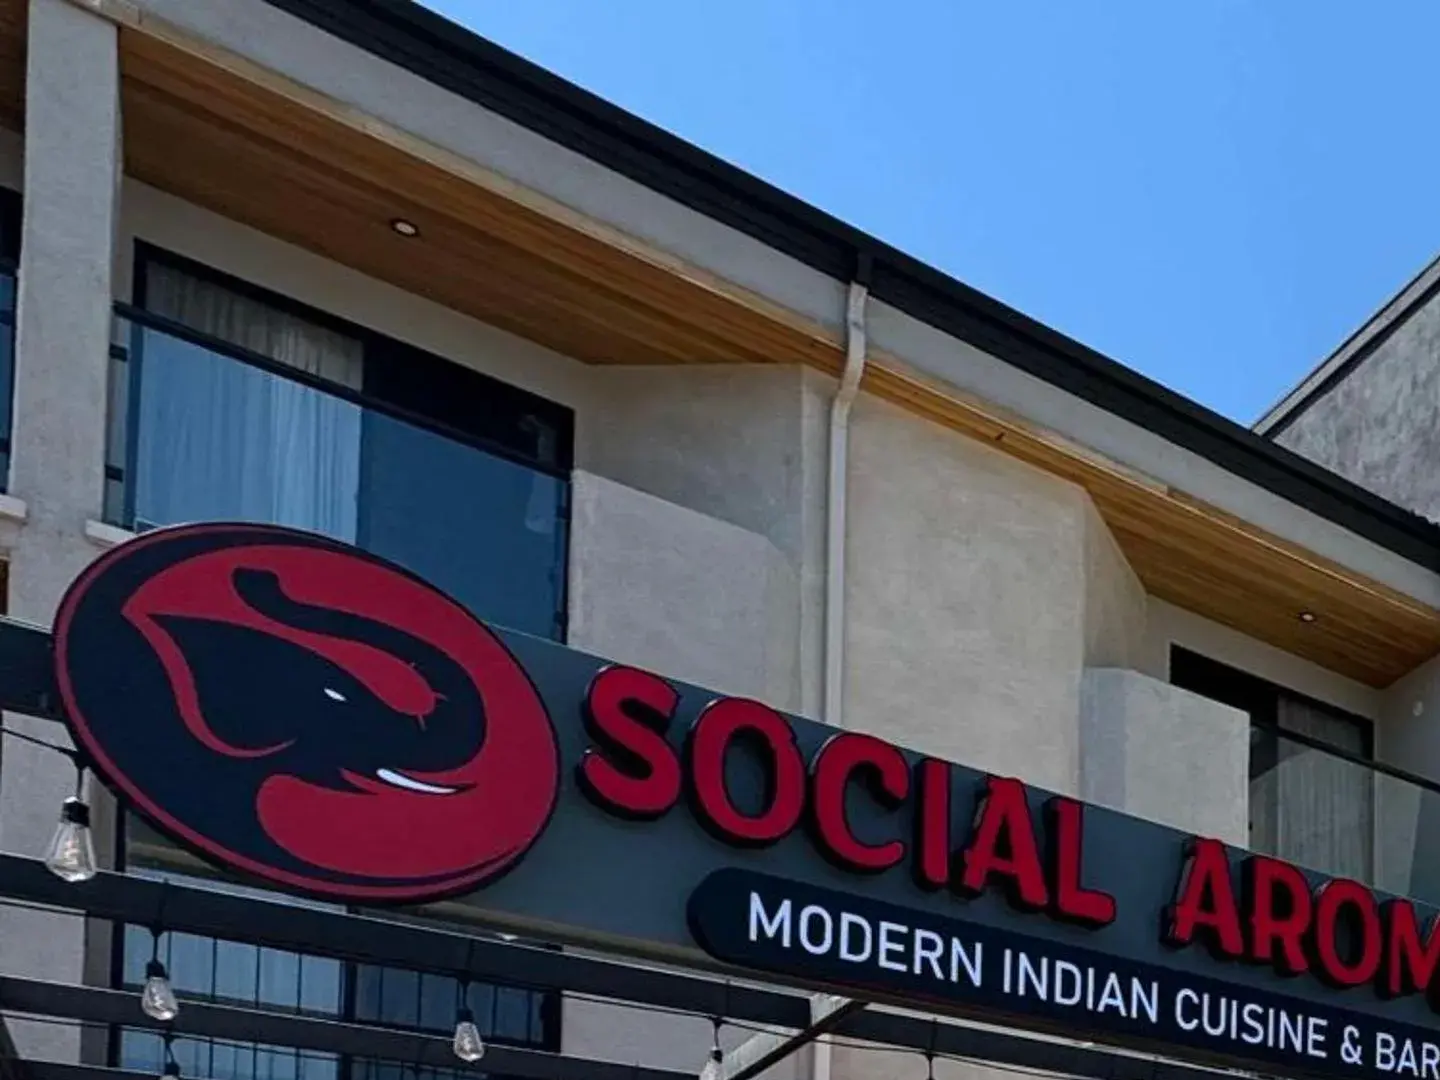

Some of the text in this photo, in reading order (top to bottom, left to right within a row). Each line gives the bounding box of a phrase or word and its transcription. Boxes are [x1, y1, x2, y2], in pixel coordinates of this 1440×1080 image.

[579, 664, 1117, 927] SOCIAL
[746, 890, 984, 987] MODERN
[1001, 946, 1161, 1025] INDIAN
[1173, 987, 1330, 1057] CUISINE
[1339, 1026, 1363, 1065] &
